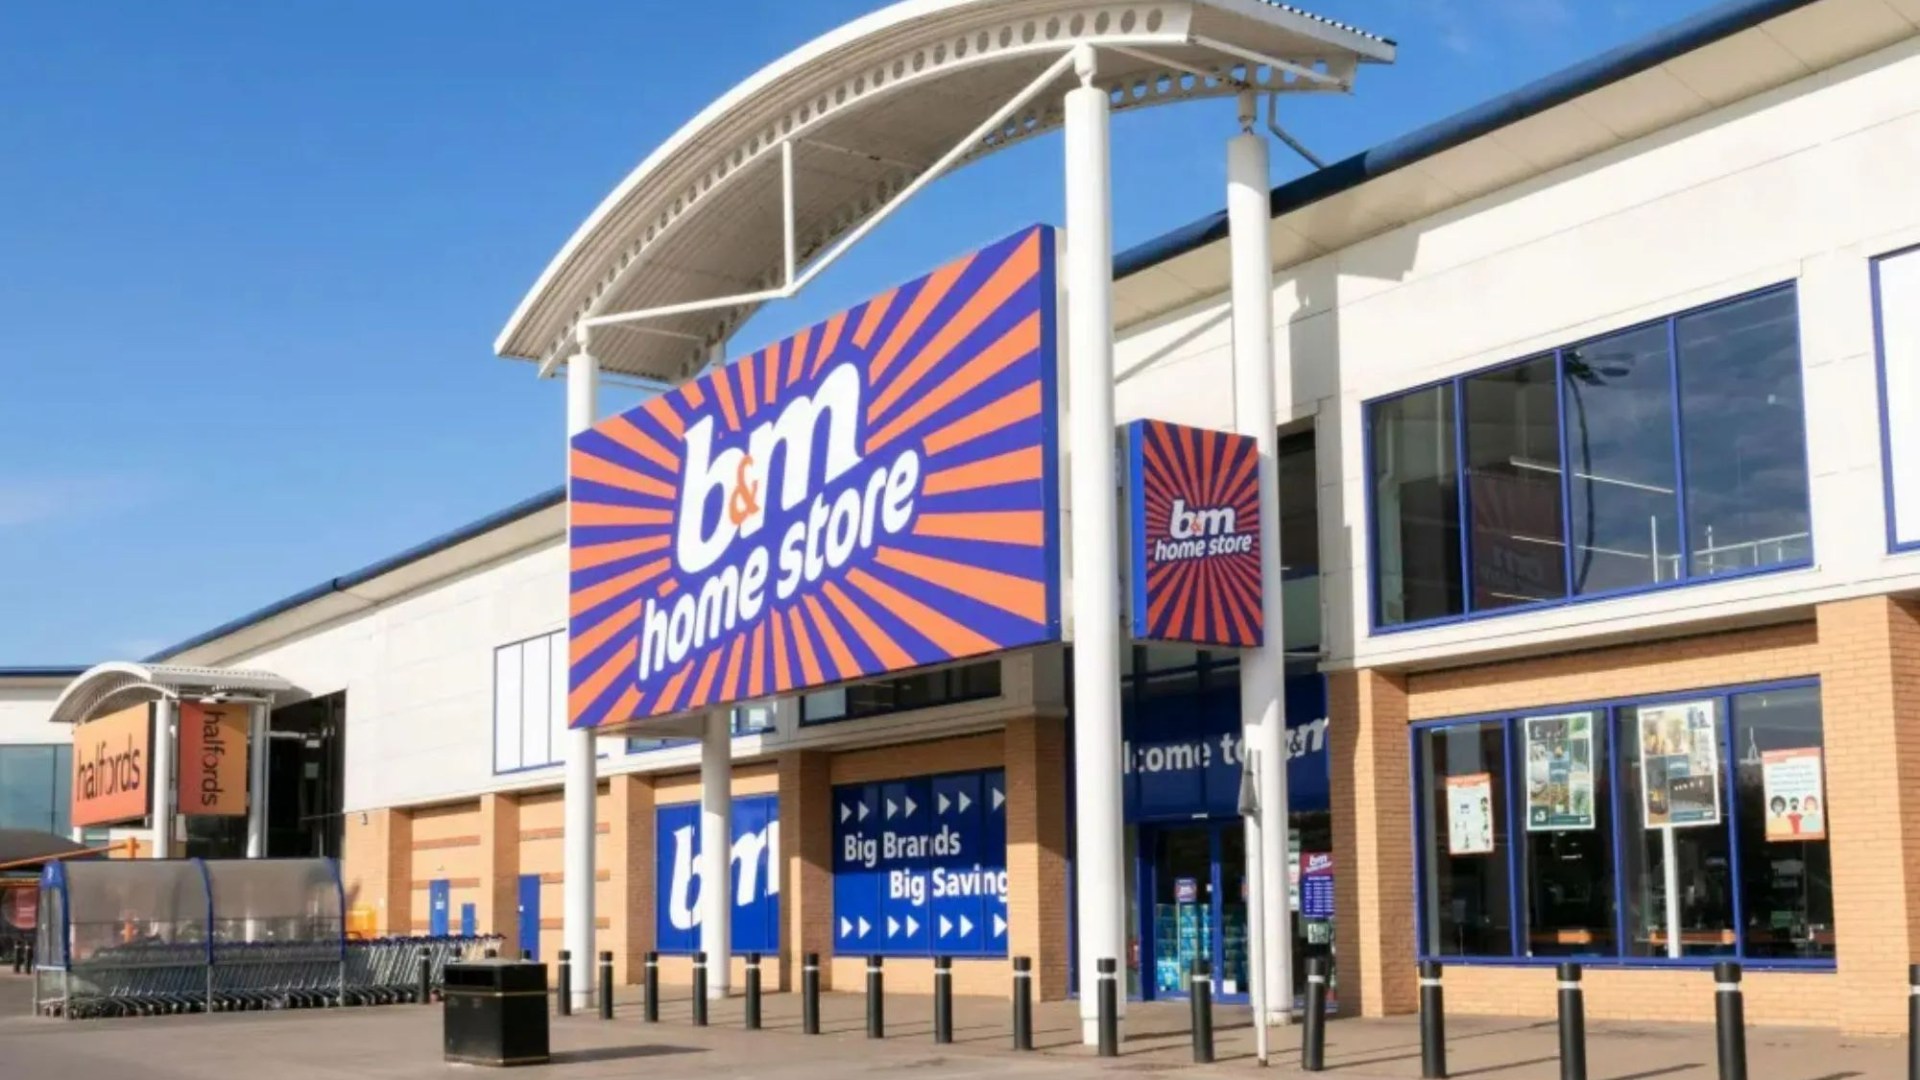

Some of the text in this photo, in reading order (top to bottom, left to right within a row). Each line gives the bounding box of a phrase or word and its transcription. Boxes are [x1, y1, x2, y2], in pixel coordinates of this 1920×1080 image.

[676, 361, 864, 573] b&m
[1169, 499, 1236, 540] b&m
[639, 448, 920, 681] home store
[1154, 534, 1252, 562] home store
[76, 732, 141, 802] halfords
[201, 709, 227, 807] halfords
[1123, 740, 1211, 774] lcome
[844, 824, 962, 868] Big Brands
[890, 867, 925, 907] Big
